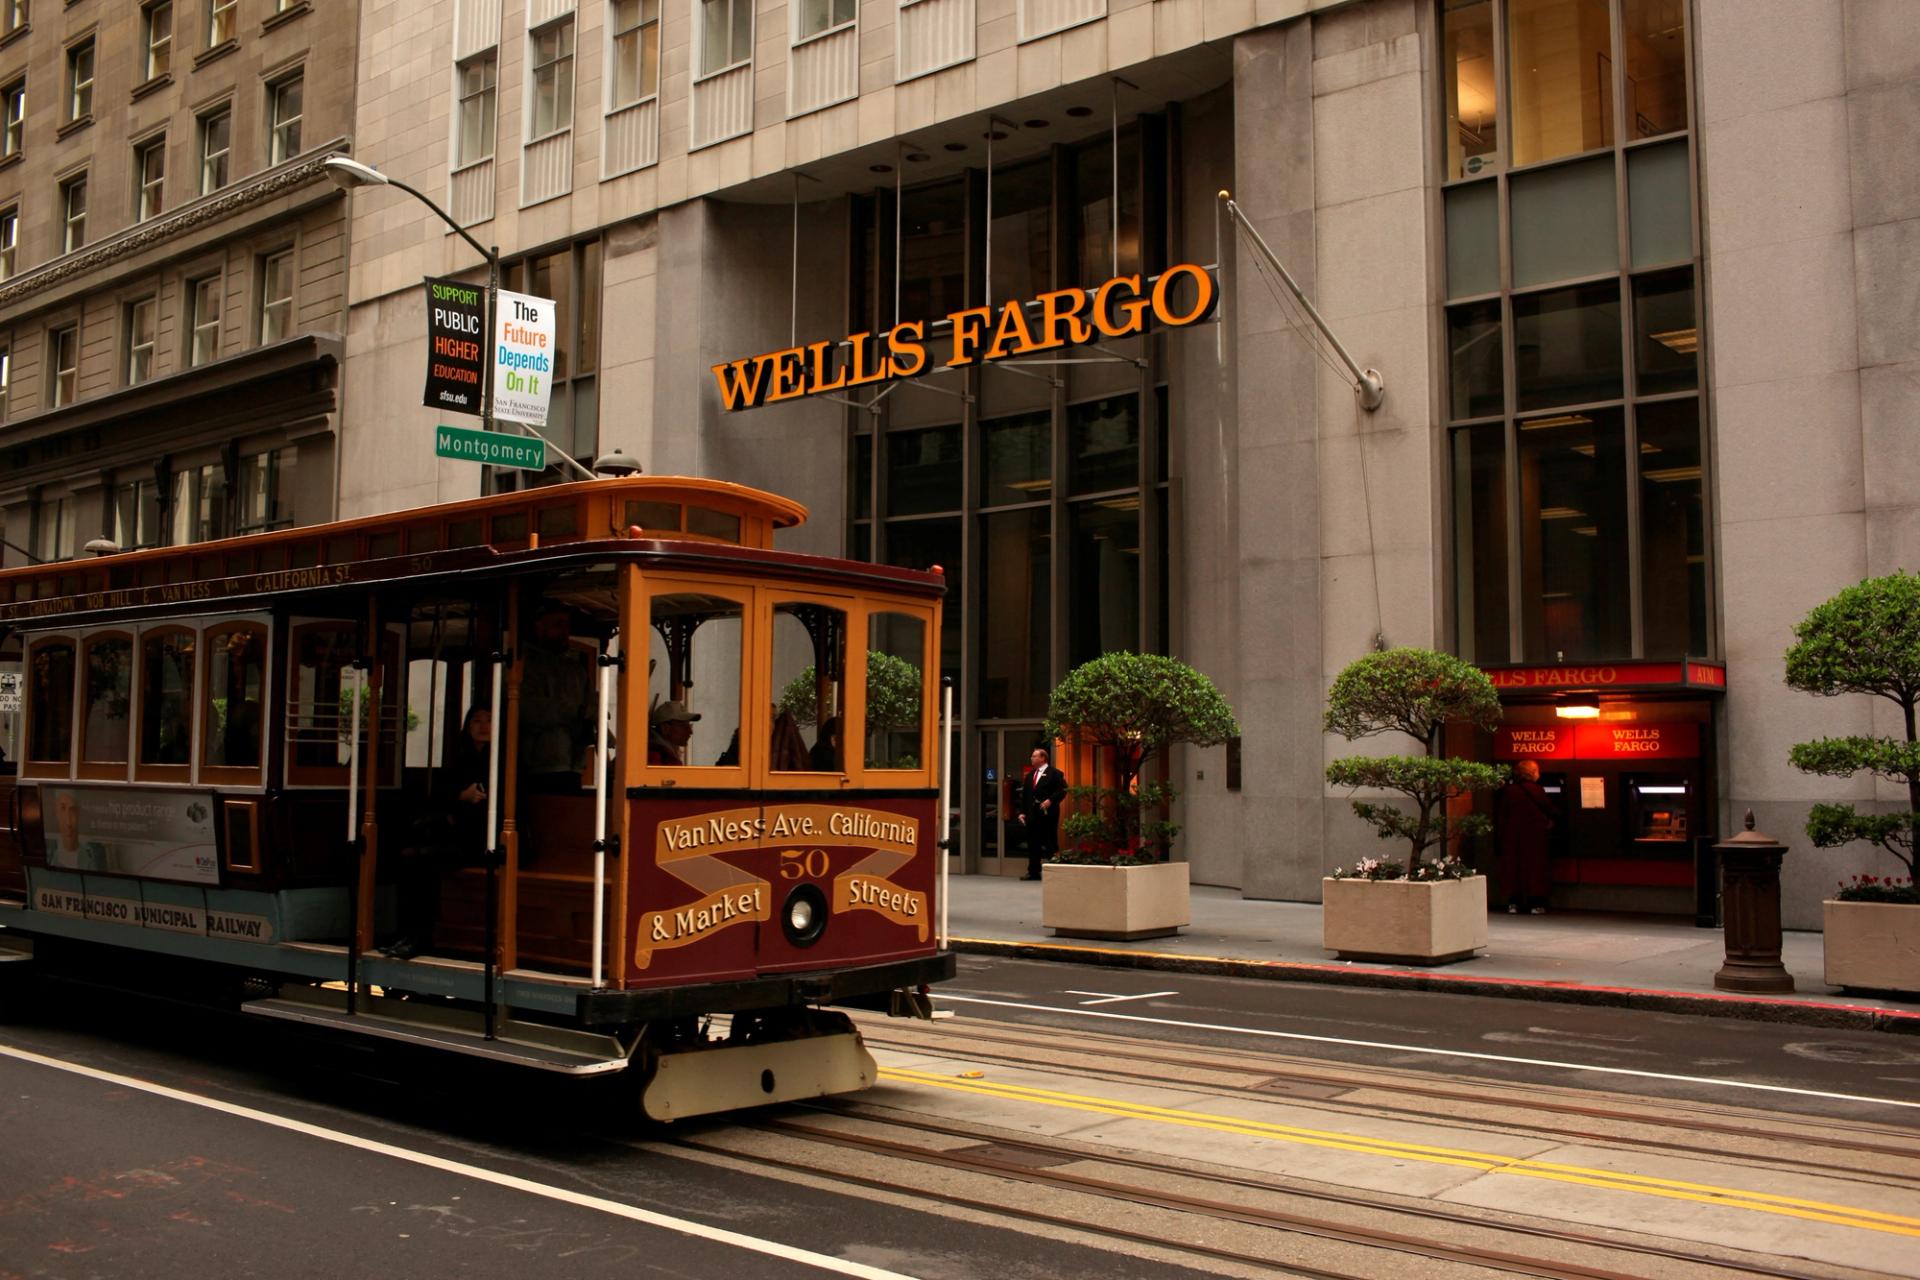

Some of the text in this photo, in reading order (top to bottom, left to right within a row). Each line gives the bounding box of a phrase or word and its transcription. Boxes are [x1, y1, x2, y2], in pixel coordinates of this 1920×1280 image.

[432, 284, 478, 306] SUPPORT
[435, 308, 479, 335] PUBLIC
[514, 301, 538, 322] The
[504, 322, 547, 348] Future
[711, 263, 1217, 411] WELLS FARGO
[435, 336, 479, 362] HIGHER
[499, 346, 549, 372] Depends
[434, 363, 478, 385] EDUCATION
[506, 371, 539, 395] On It
[439, 390, 468, 405] sfsu.edu
[495, 397, 545, 412] SAN FRANCISCO
[439, 433, 542, 464] Montgomery
[411, 556, 433, 573] 50
[110, 591, 130, 606] HILL
[161, 586, 180, 601] VAN
[182, 582, 209, 600] NESS
[254, 566, 330, 592] CALIFORNIA
[1534, 667, 1616, 685] FARGO
[1696, 667, 1715, 684] ATM
[1511, 731, 1555, 741] WELLS
[1612, 729, 1660, 740] WELLS
[1614, 741, 1660, 751] FARGO
[1512, 742, 1555, 753] FARGO
[663, 824, 705, 852] Van
[707, 817, 766, 845] Ness
[829, 812, 917, 845] California
[779, 848, 831, 881] 50
[849, 878, 919, 916] Streets
[41, 893, 261, 937] SAN FRANCISCO MUNICIPAL RAILWAY
[651, 887, 761, 941] & Market
